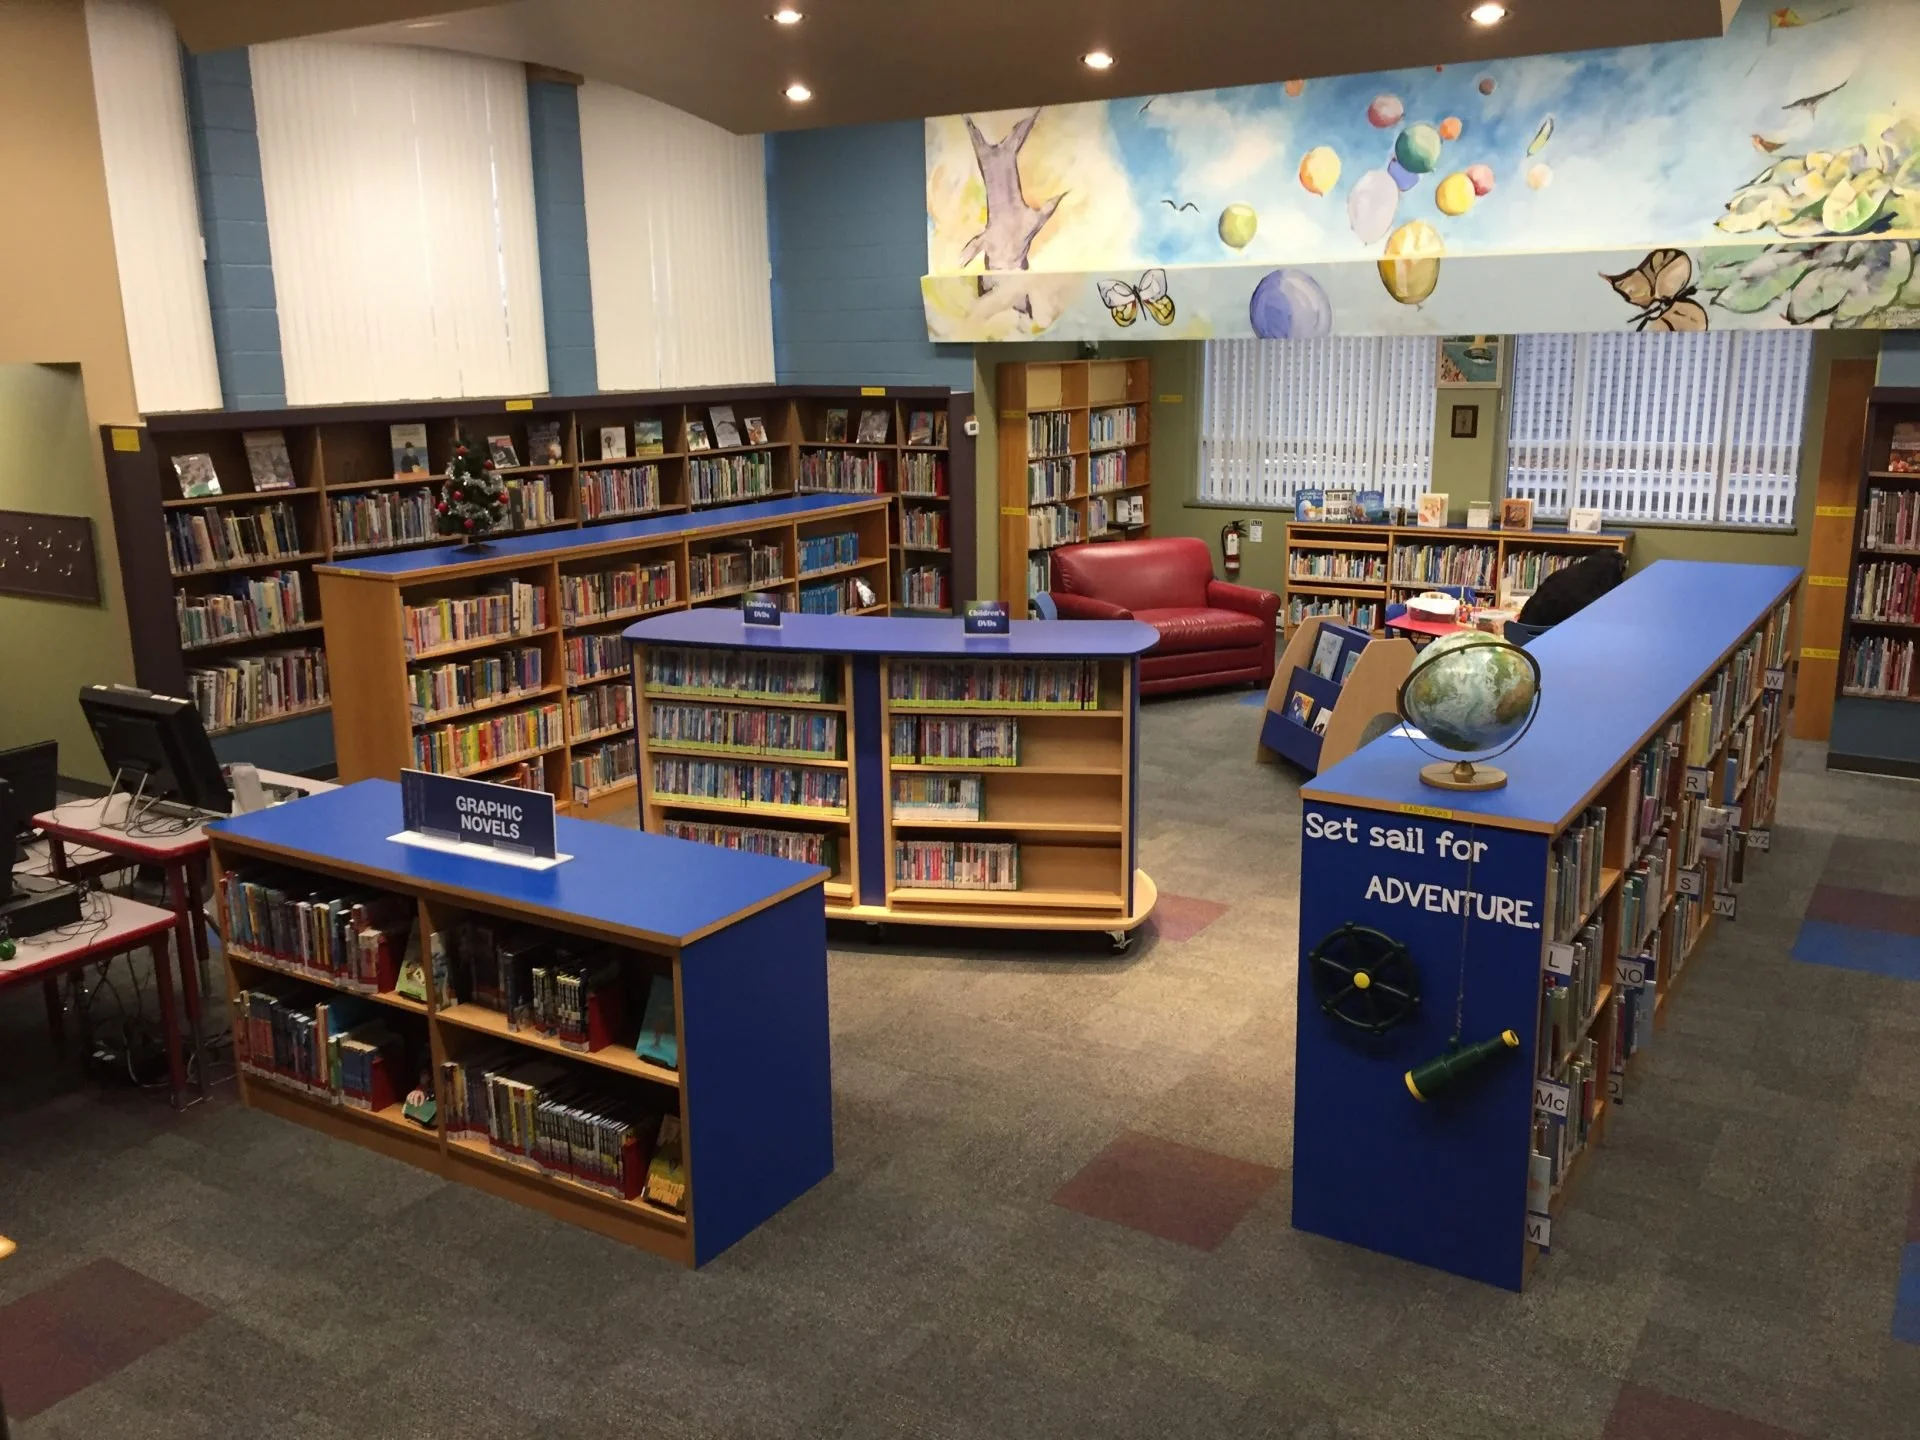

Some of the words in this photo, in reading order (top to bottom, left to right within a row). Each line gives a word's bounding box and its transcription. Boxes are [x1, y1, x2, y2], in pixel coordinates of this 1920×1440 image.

[968, 608, 1005, 617] Children's
[977, 619, 997, 627] DVDs
[1766, 675, 1780, 688] W
[1686, 776, 1698, 791] R
[455, 795, 523, 822] GRAPHIC
[460, 814, 520, 840] NOVELS
[1305, 811, 1358, 844] Set
[1369, 826, 1425, 855] sail
[1435, 830, 1489, 863] for
[1680, 876, 1691, 890] S
[1364, 875, 1541, 929] ADVENTURE.
[1711, 899, 1733, 914] UV
[1548, 950, 1560, 968] L
[1535, 1087, 1566, 1112] Mc
[1527, 1224, 1541, 1241] M
